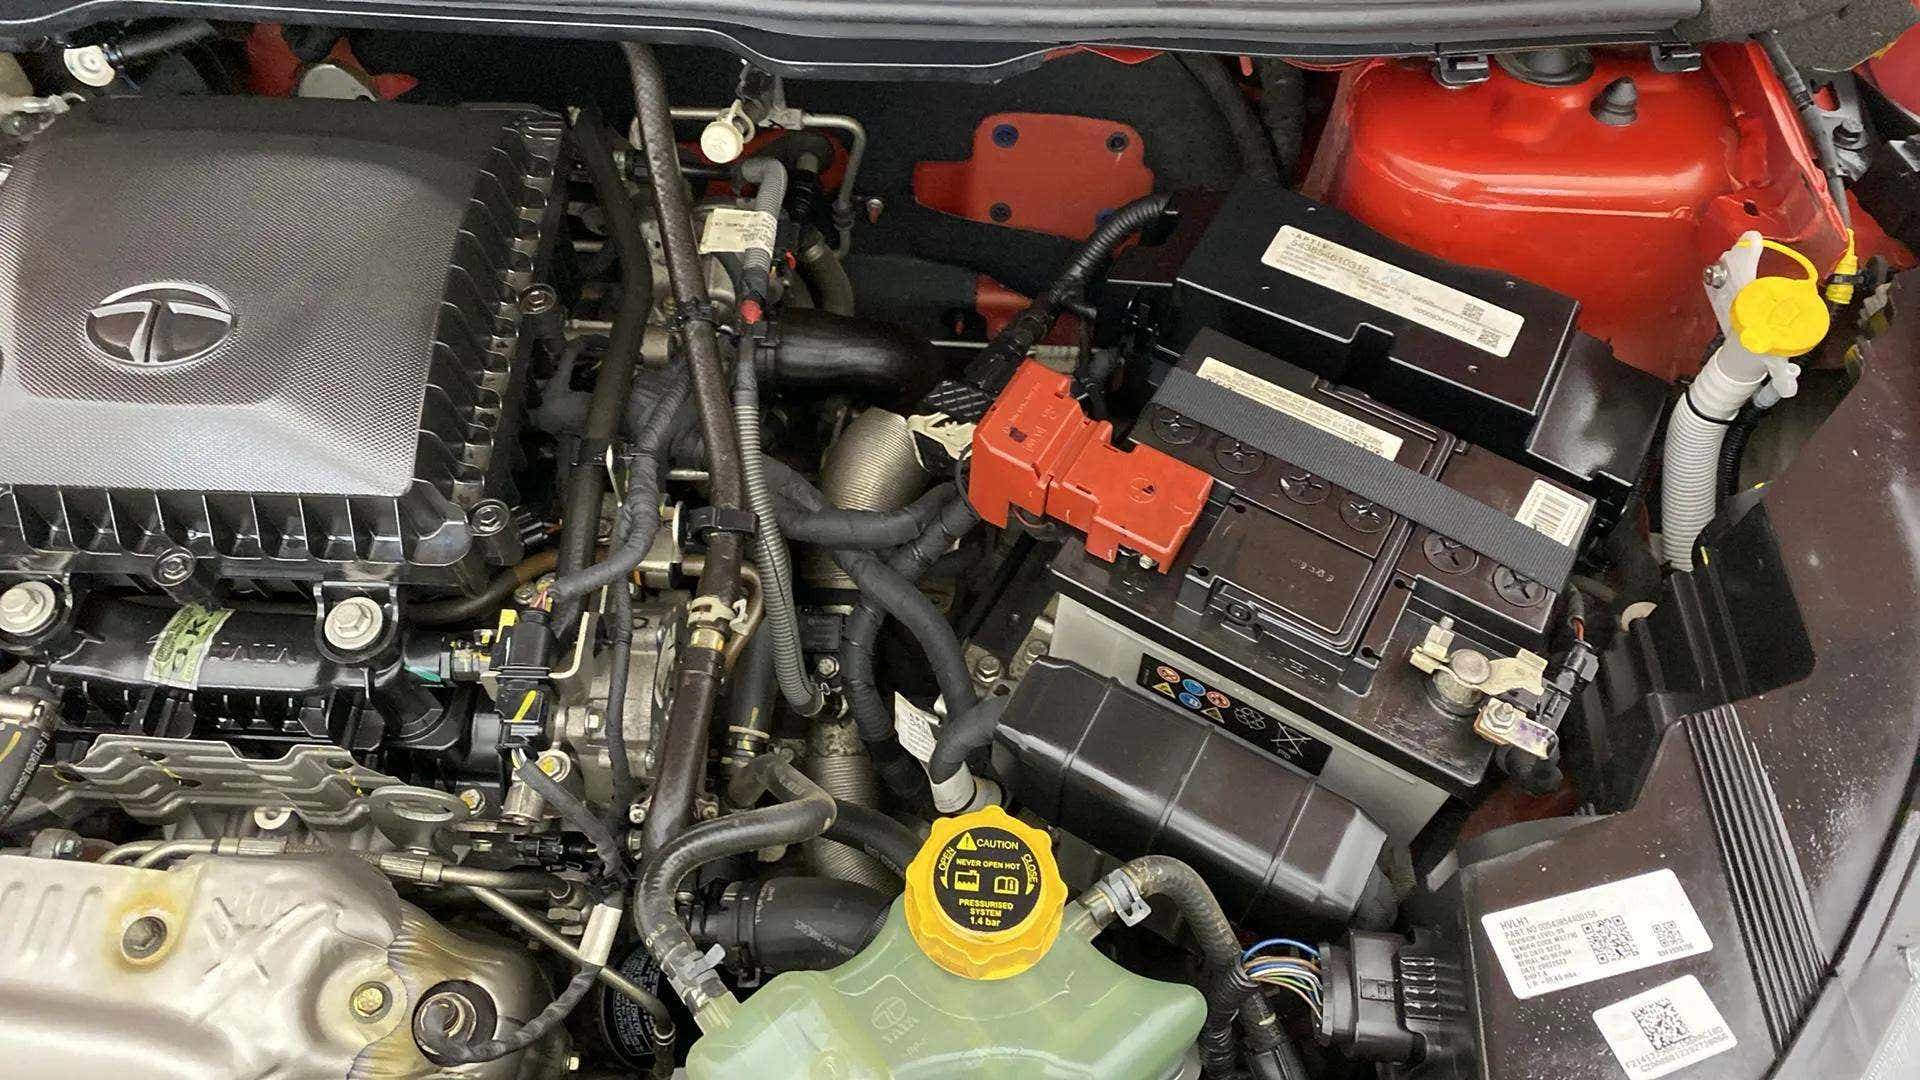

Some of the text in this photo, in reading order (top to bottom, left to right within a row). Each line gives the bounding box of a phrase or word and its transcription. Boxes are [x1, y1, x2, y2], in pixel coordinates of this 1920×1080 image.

[976, 838, 1019, 851] CAUTION
[938, 846, 955, 871] OPEN
[956, 857, 1021, 871] NEVER OPEN HOT
[1023, 853, 1038, 883] CLOSE
[959, 898, 1014, 911] PRESSURISED
[970, 907, 1002, 917] SYSTEM
[970, 916, 1002, 927] 1.4 bar
